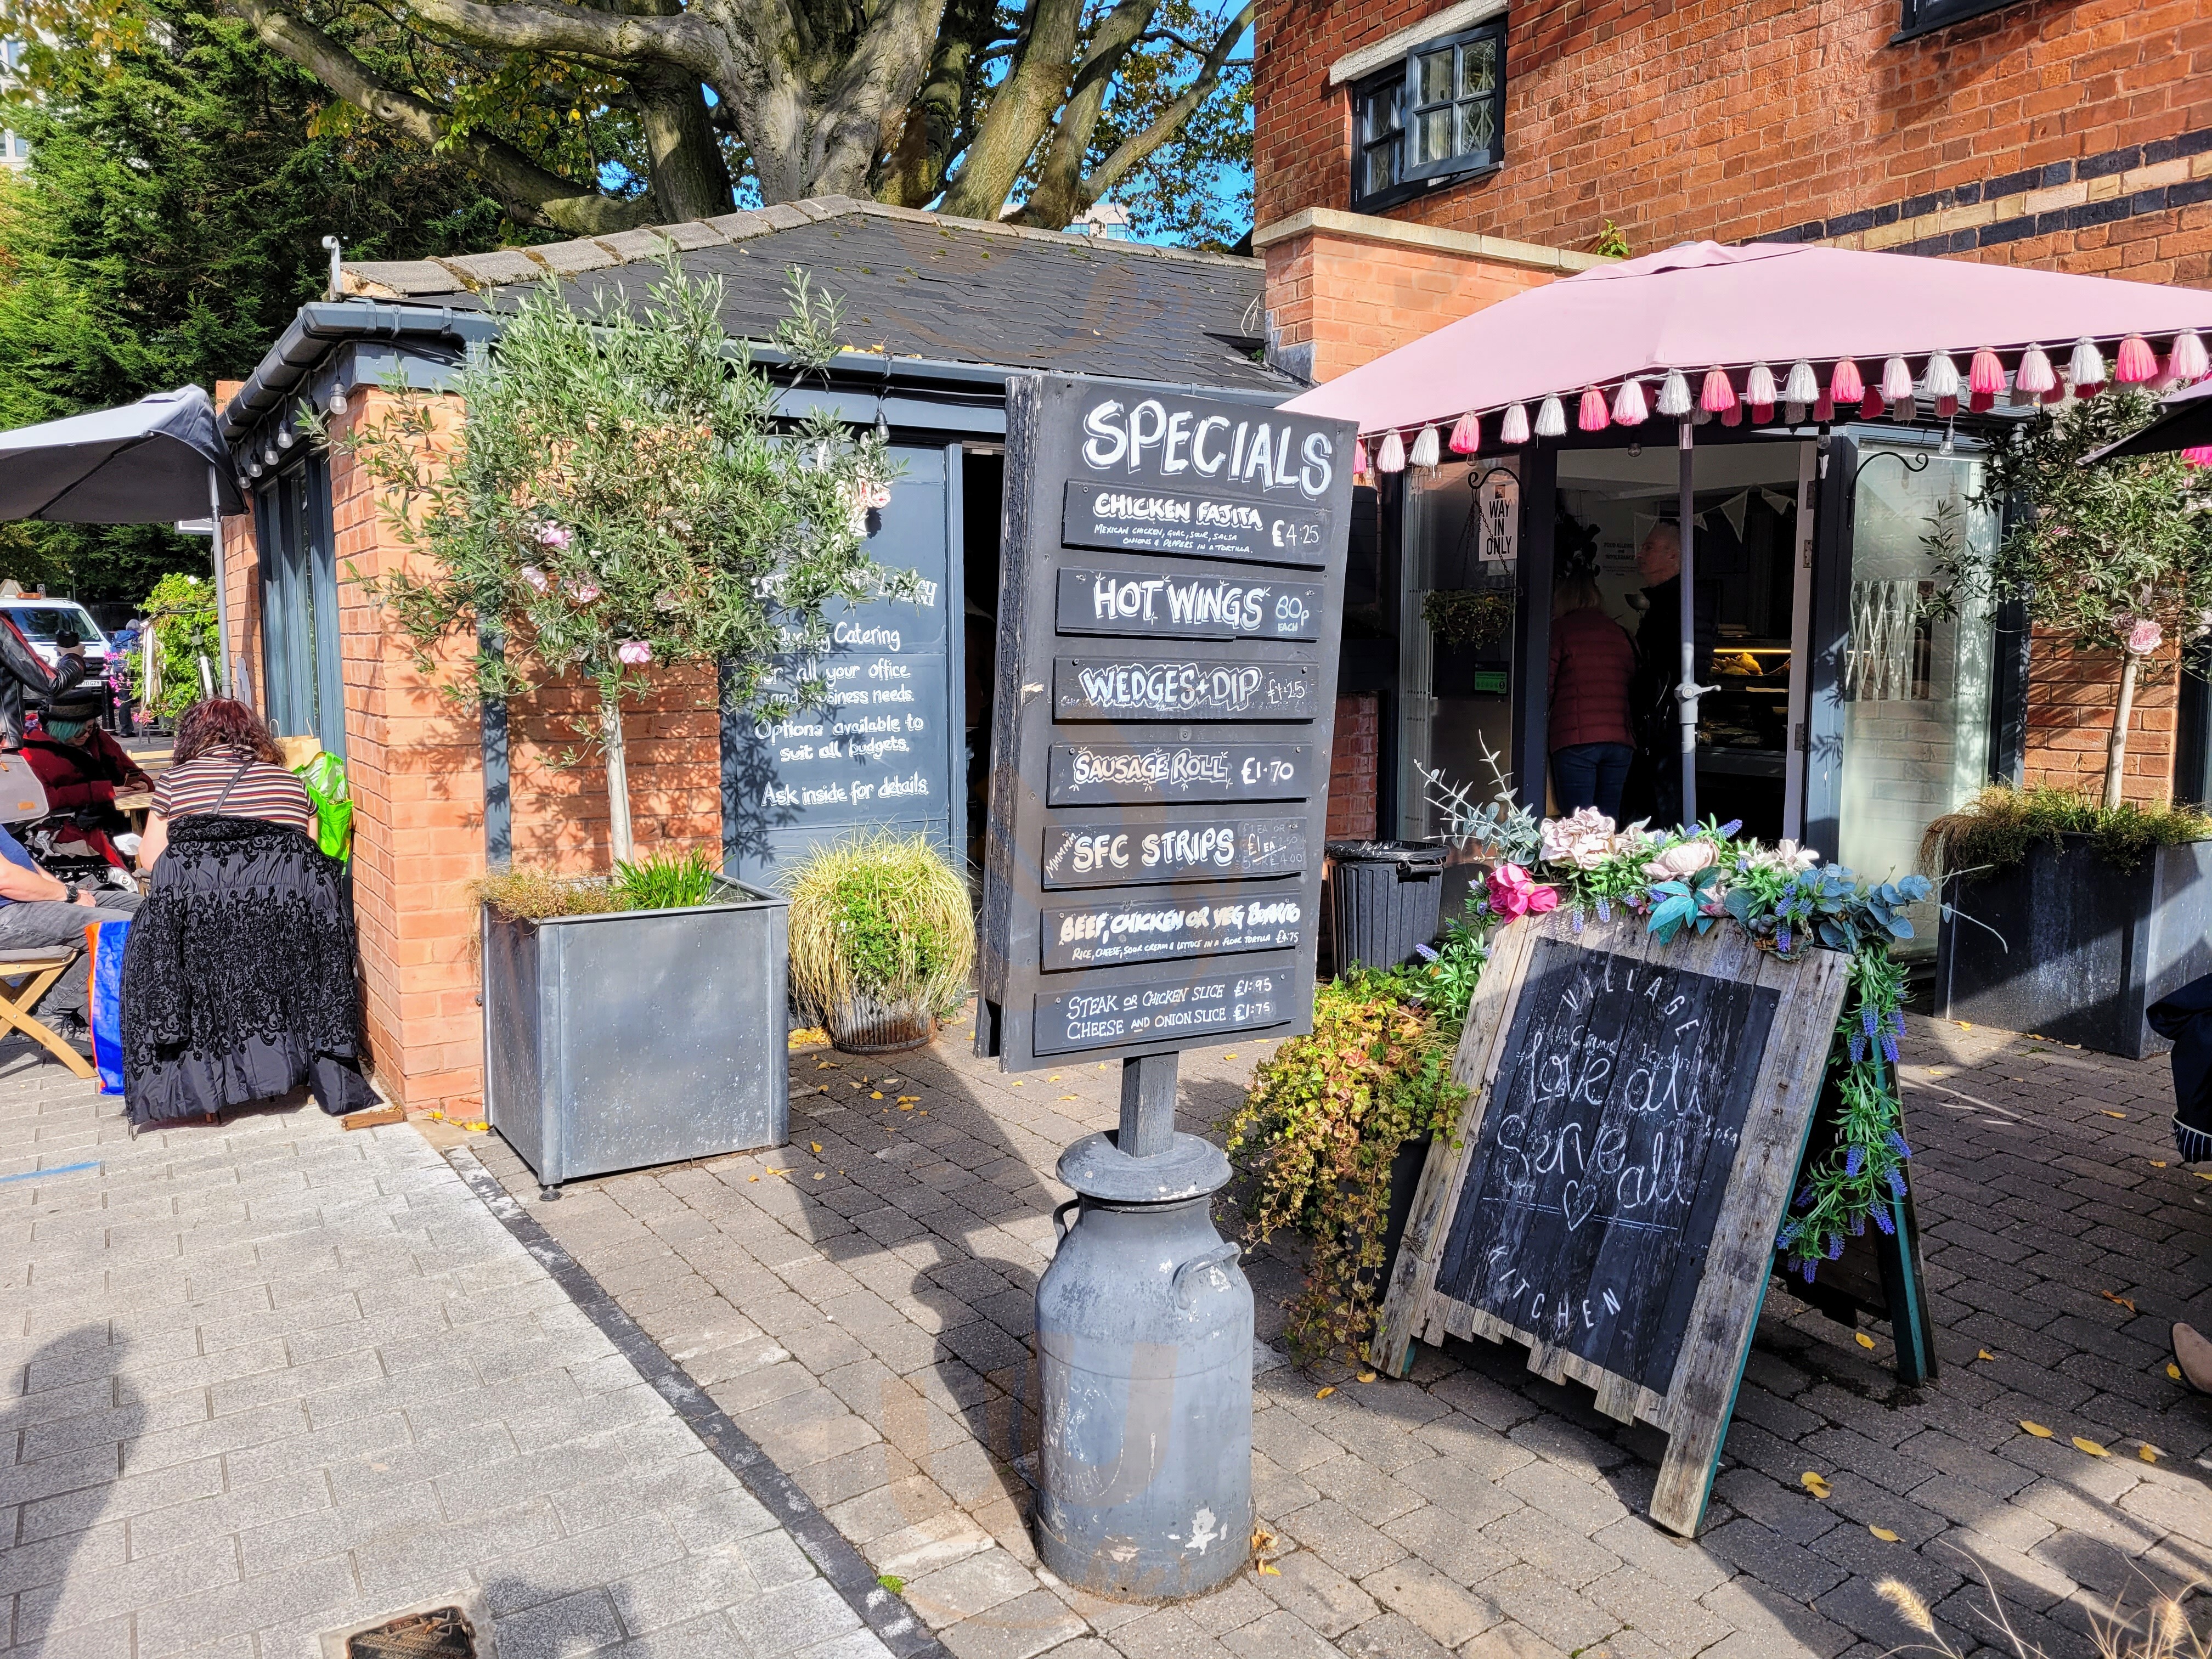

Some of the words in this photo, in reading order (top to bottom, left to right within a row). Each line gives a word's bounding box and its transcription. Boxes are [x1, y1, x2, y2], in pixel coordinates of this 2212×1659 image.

[1082, 399, 1333, 501] SPECIALS
[1093, 493, 1190, 523] CHICKEN
[1196, 501, 1263, 531] FAJITA
[1489, 500, 1510, 518] WAY
[1094, 523, 1128, 534] MEXICAN
[1132, 526, 1165, 539] CHICKEN,
[1494, 518, 1504, 536] IN
[1163, 539, 1194, 549] PEPPERS
[1486, 536, 1512, 555] ONLY
[1093, 578, 1164, 620] HOT
[1166, 580, 1265, 630] WINGS
[1276, 595, 1310, 626] 80p
[834, 621, 900, 651] Catering
[1278, 622, 1298, 632] EACH
[796, 657, 817, 682] all
[826, 665, 860, 690] your
[868, 657, 911, 681] office
[770, 687, 798, 706] and
[805, 688, 869, 707] usiness
[872, 684, 915, 703] needs.
[754, 718, 823, 746] Options
[833, 715, 901, 736] available
[905, 713, 924, 732] to
[780, 743, 814, 762] suit
[819, 740, 842, 759] all
[849, 736, 910, 760] budgets.
[1074, 751, 1170, 785] SAUSAGE
[1171, 748, 1228, 785] ROLL
[761, 780, 800, 807] Ask
[802, 782, 848, 806] inside
[849, 780, 875, 806] for
[878, 771, 930, 799] details.
[1073, 834, 1130, 873] SFC
[1142, 827, 1235, 867] STRIPS
[1248, 833, 1261, 856] £1
[1263, 841, 1276, 853] EA
[1110, 909, 1185, 933] CHICKEN
[1186, 906, 1210, 928] OR
[1212, 905, 1245, 930] VEG
[1124, 945, 1142, 955] SOUR
[1177, 940, 1203, 950] LETTUCE
[1204, 940, 1213, 948] IN
[1066, 995, 1119, 1020] STEAK
[1124, 995, 1138, 1007] OR
[1142, 988, 1189, 1006] CHICKEN
[1192, 984, 1225, 1001] SLICE
[1562, 969, 1700, 1037] VILLAGE
[1067, 1019, 1124, 1040] CHEESE
[1131, 1017, 1150, 1030] AND
[1154, 1011, 1192, 1028] ONION
[1194, 1007, 1226, 1023] SLICE
[1624, 1045, 1703, 1116] all
[1616, 1131, 1692, 1209] all
[1489, 1245, 1621, 1329] KITCHEN
